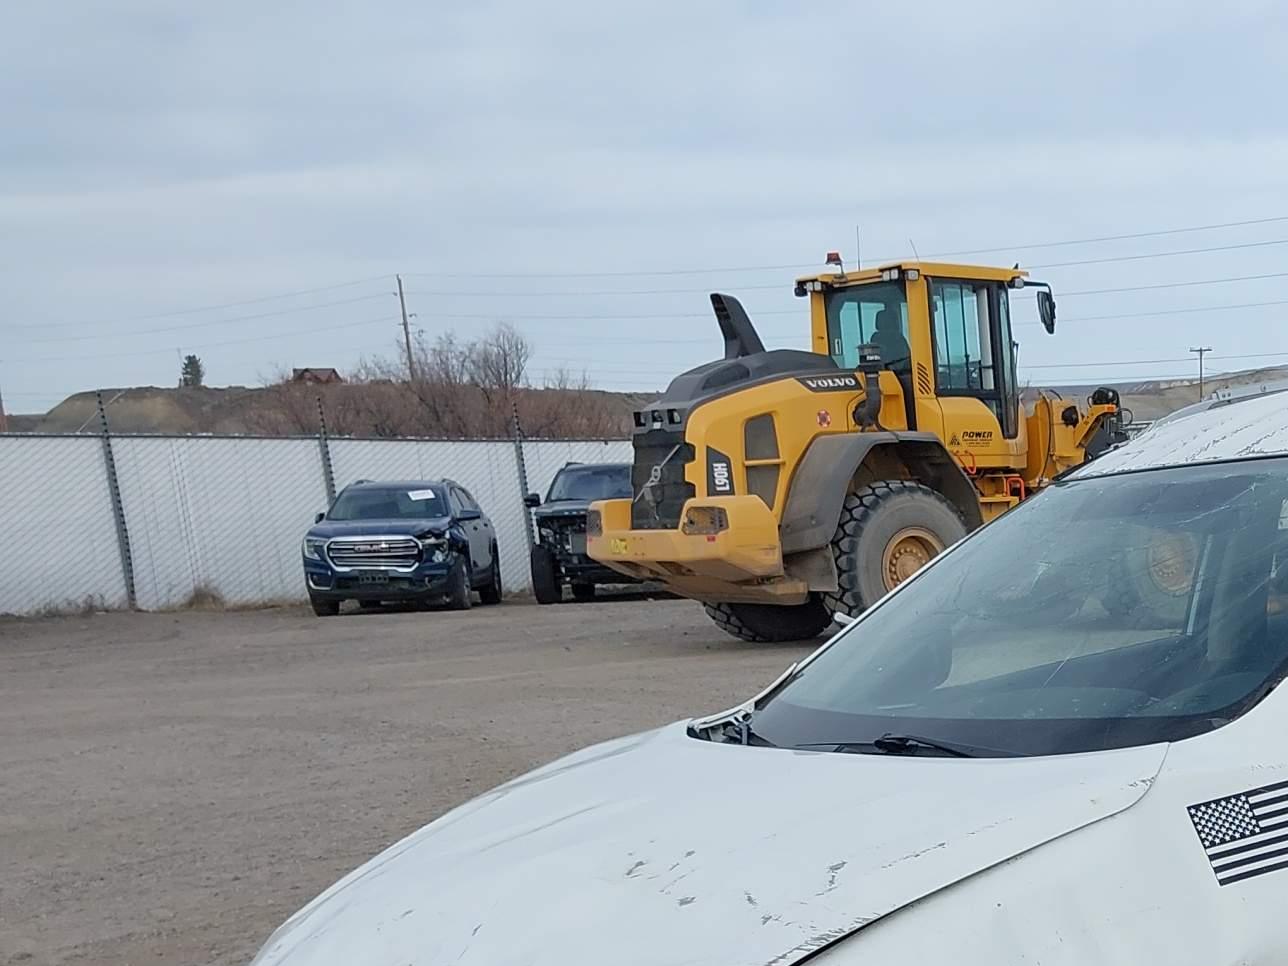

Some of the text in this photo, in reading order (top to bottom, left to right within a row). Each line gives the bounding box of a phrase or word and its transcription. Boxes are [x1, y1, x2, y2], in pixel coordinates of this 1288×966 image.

[806, 377, 856, 388] VOLVO
[962, 431, 993, 439] POWER
[712, 462, 730, 491] L90H
